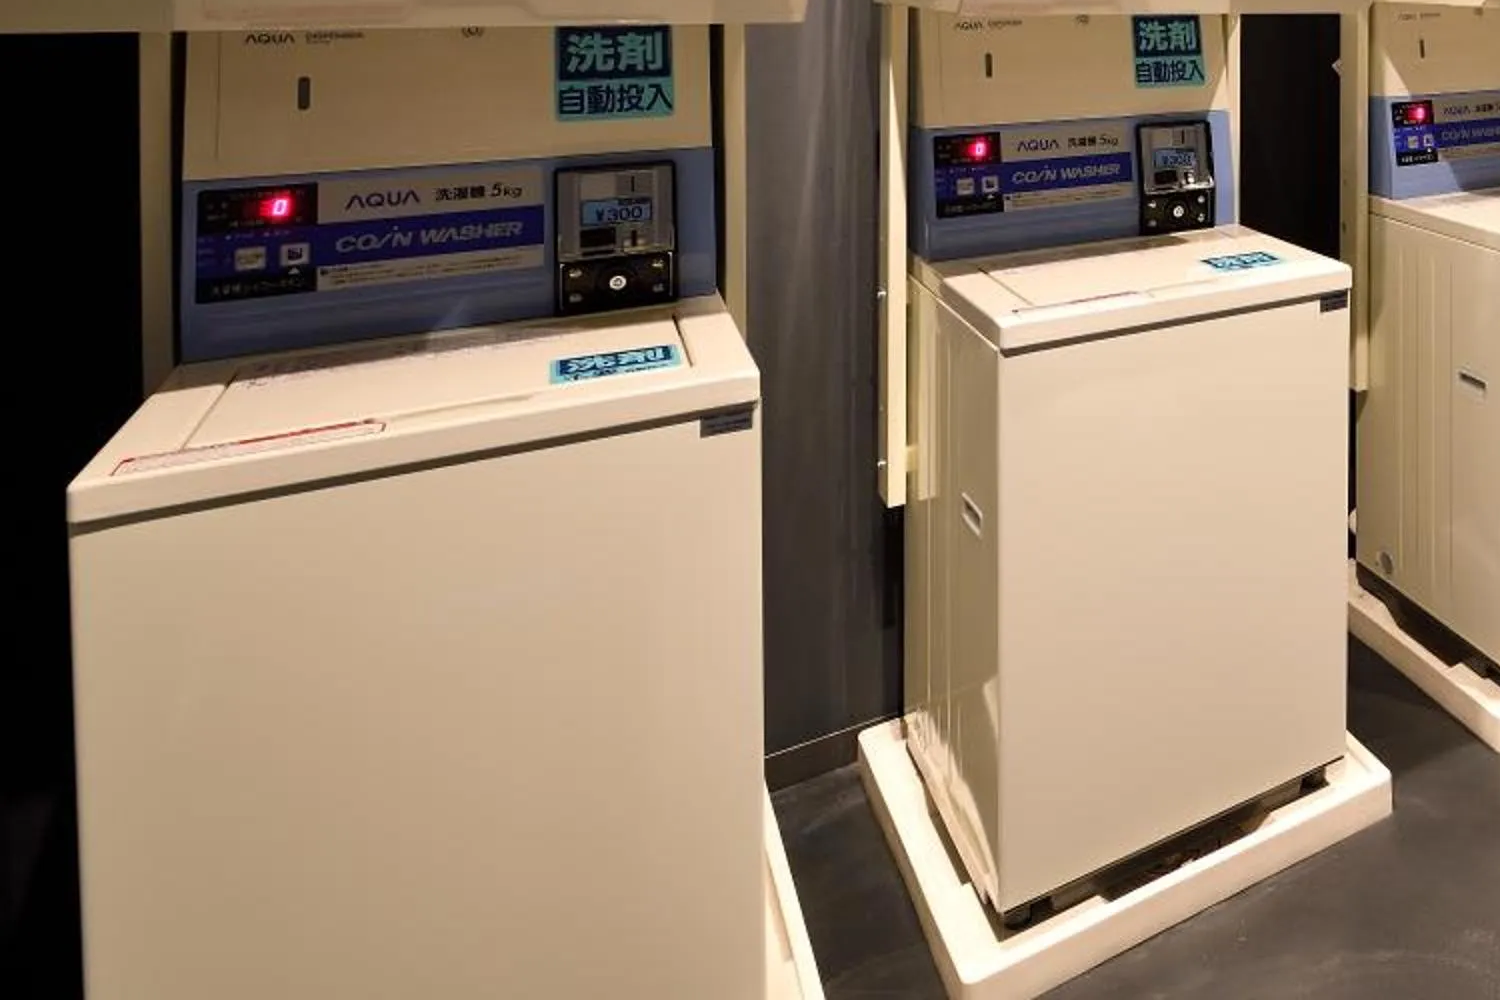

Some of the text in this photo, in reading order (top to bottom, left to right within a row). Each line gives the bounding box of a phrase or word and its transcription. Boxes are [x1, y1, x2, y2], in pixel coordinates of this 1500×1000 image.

[245, 33, 295, 45] AQUA
[1139, 20, 1197, 51] 洗剤
[567, 32, 664, 73] 洗剤
[1137, 59, 1205, 83] 自動投入
[559, 83, 673, 115] 自動投入
[344, 189, 420, 210] AQUA
[420, 221, 523, 244] WASHER
